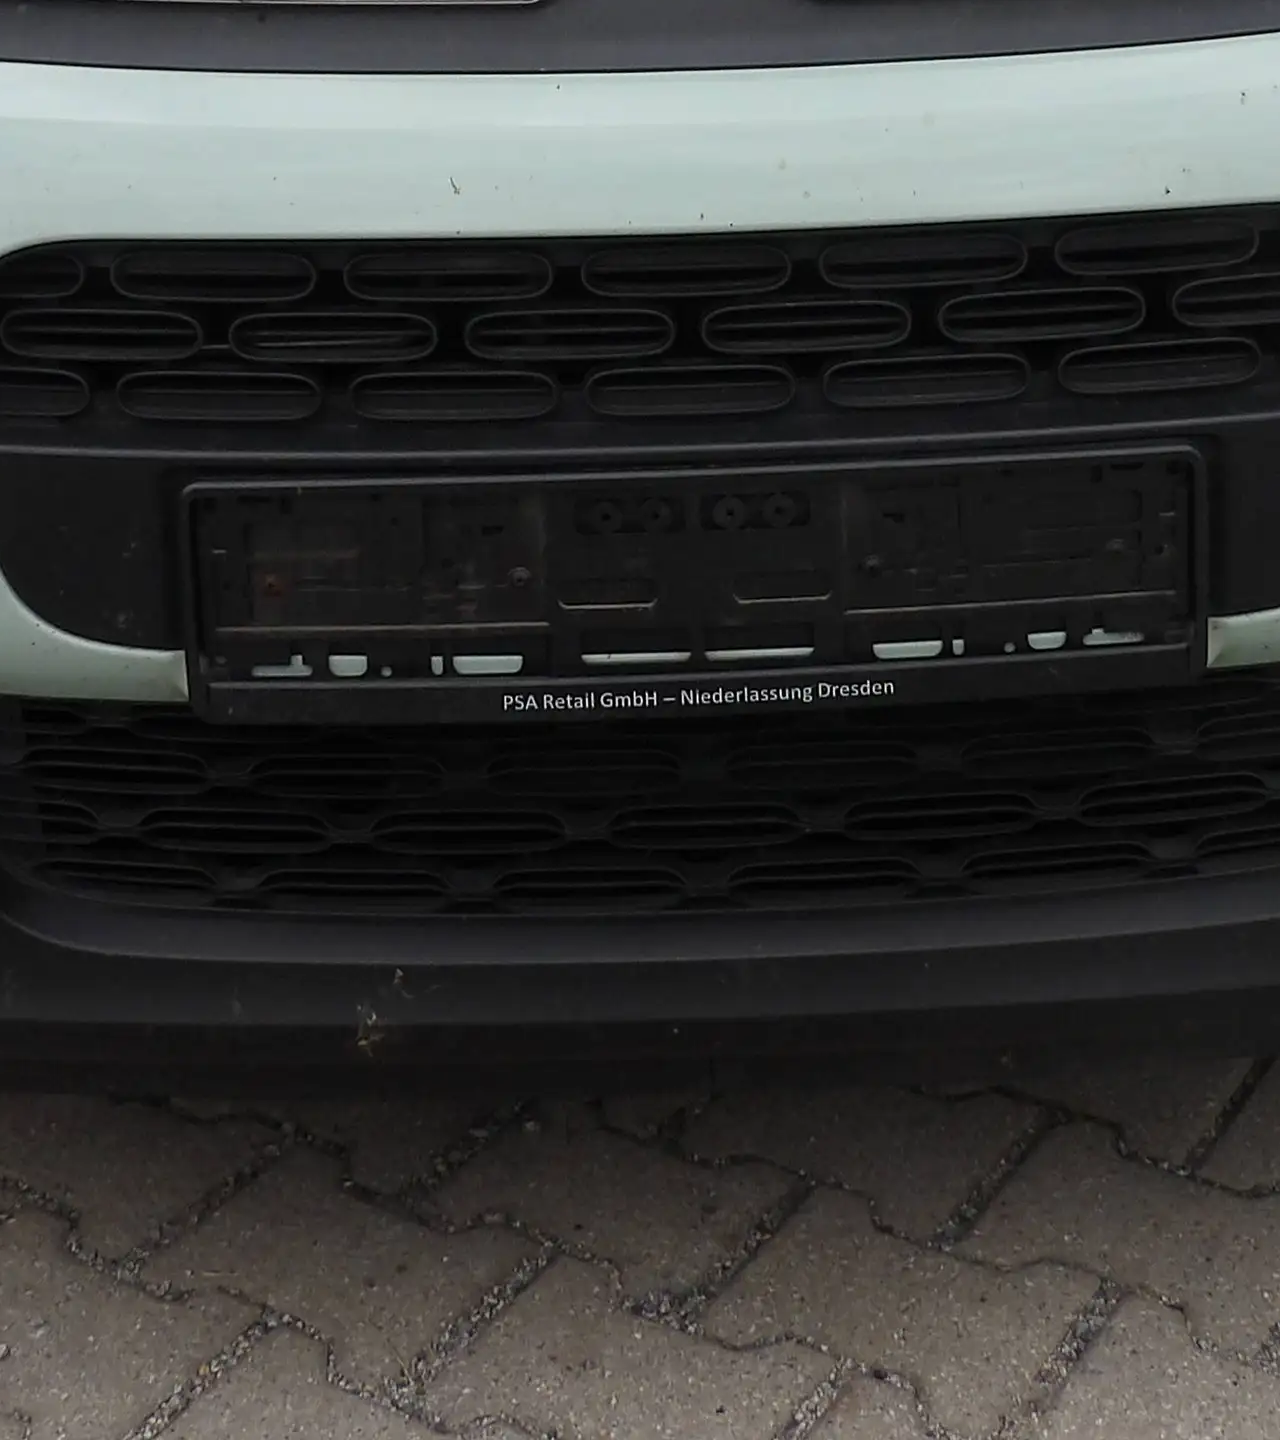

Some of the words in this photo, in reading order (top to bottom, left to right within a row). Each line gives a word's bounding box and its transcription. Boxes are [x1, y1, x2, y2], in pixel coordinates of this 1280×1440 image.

[503, 694, 538, 711] PSA
[543, 692, 595, 710] Retail
[600, 690, 658, 708] GmbH
[680, 686, 813, 706] Niederlassung
[818, 679, 895, 698] Dresden
